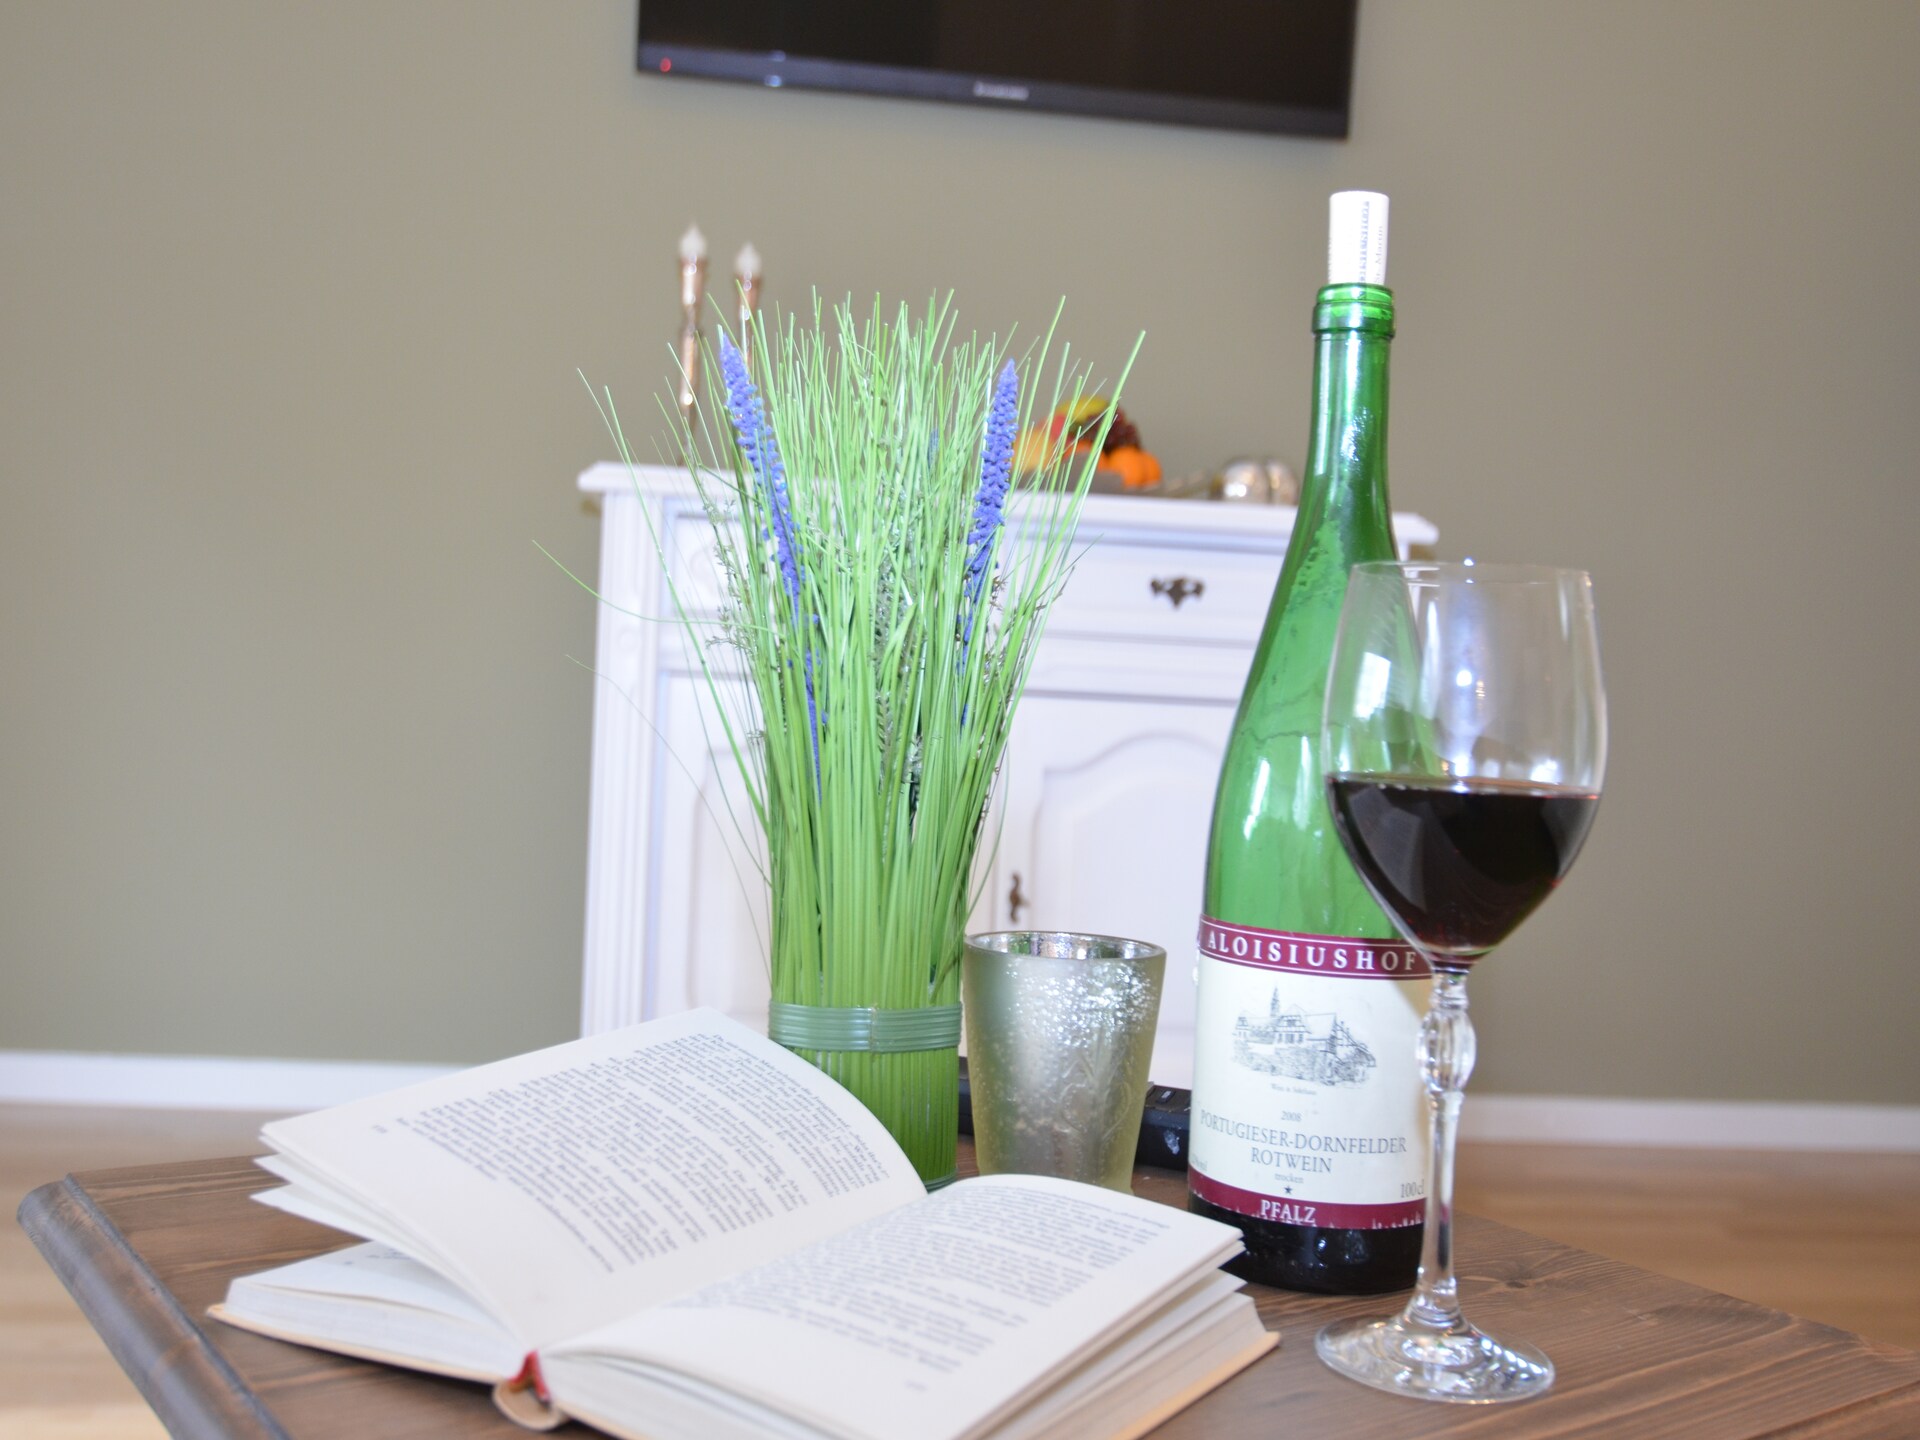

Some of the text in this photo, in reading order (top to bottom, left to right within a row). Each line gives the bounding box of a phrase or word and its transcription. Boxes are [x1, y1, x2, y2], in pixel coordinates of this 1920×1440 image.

[1207, 929, 1418, 971] ALOISIUSHOF
[1200, 1108, 1407, 1154] PORTUGIESER-DORNFELDER
[1251, 1146, 1332, 1173] ROTWEIN
[1260, 1199, 1317, 1223] PFALZ
